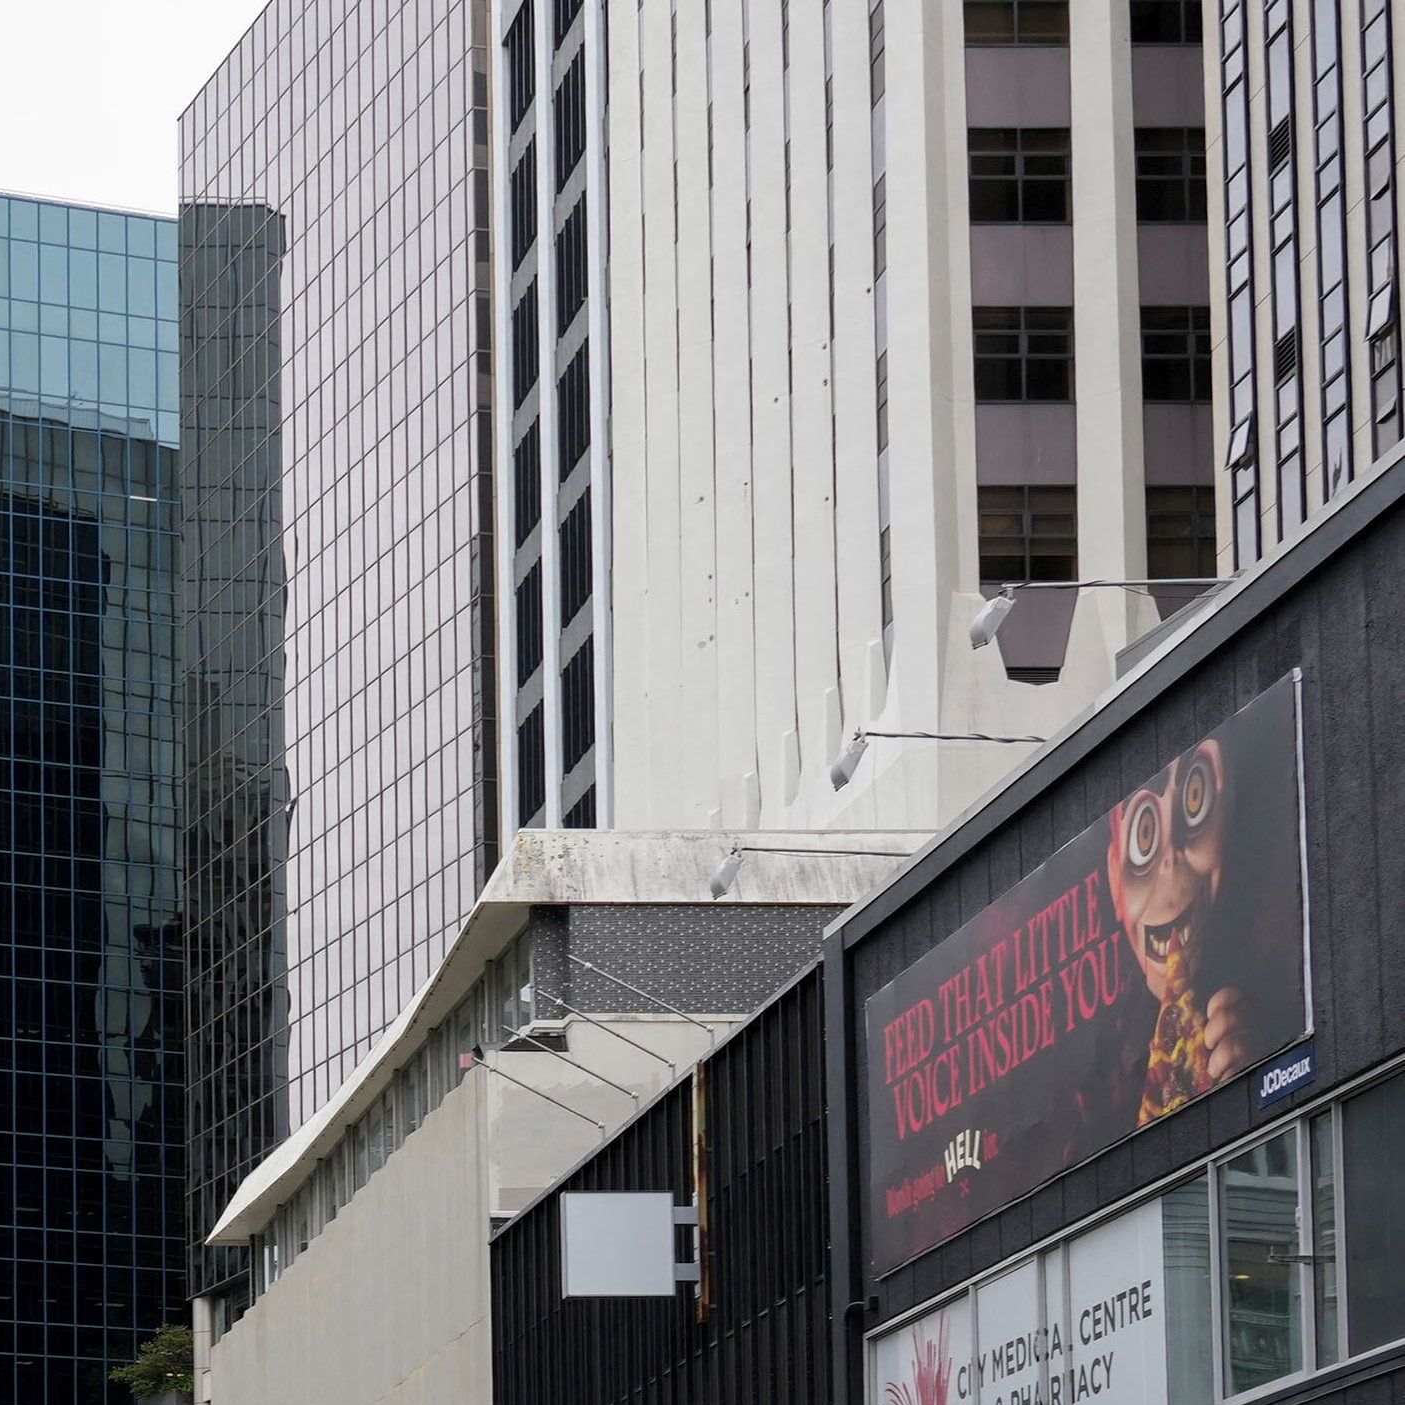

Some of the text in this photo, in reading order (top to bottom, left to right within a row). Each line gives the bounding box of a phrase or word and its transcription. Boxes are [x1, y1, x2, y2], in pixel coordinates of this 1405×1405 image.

[884, 871, 1101, 1085] FEED THAT LITTLE
[893, 1044, 963, 1141] VOICE
[967, 979, 1056, 1096] INSIDE
[1260, 1056, 1310, 1097] JCDecaux
[944, 1129, 981, 1183] HELL
[958, 1353, 986, 1399] CIY
[1080, 1280, 1152, 1345] CENTRE
